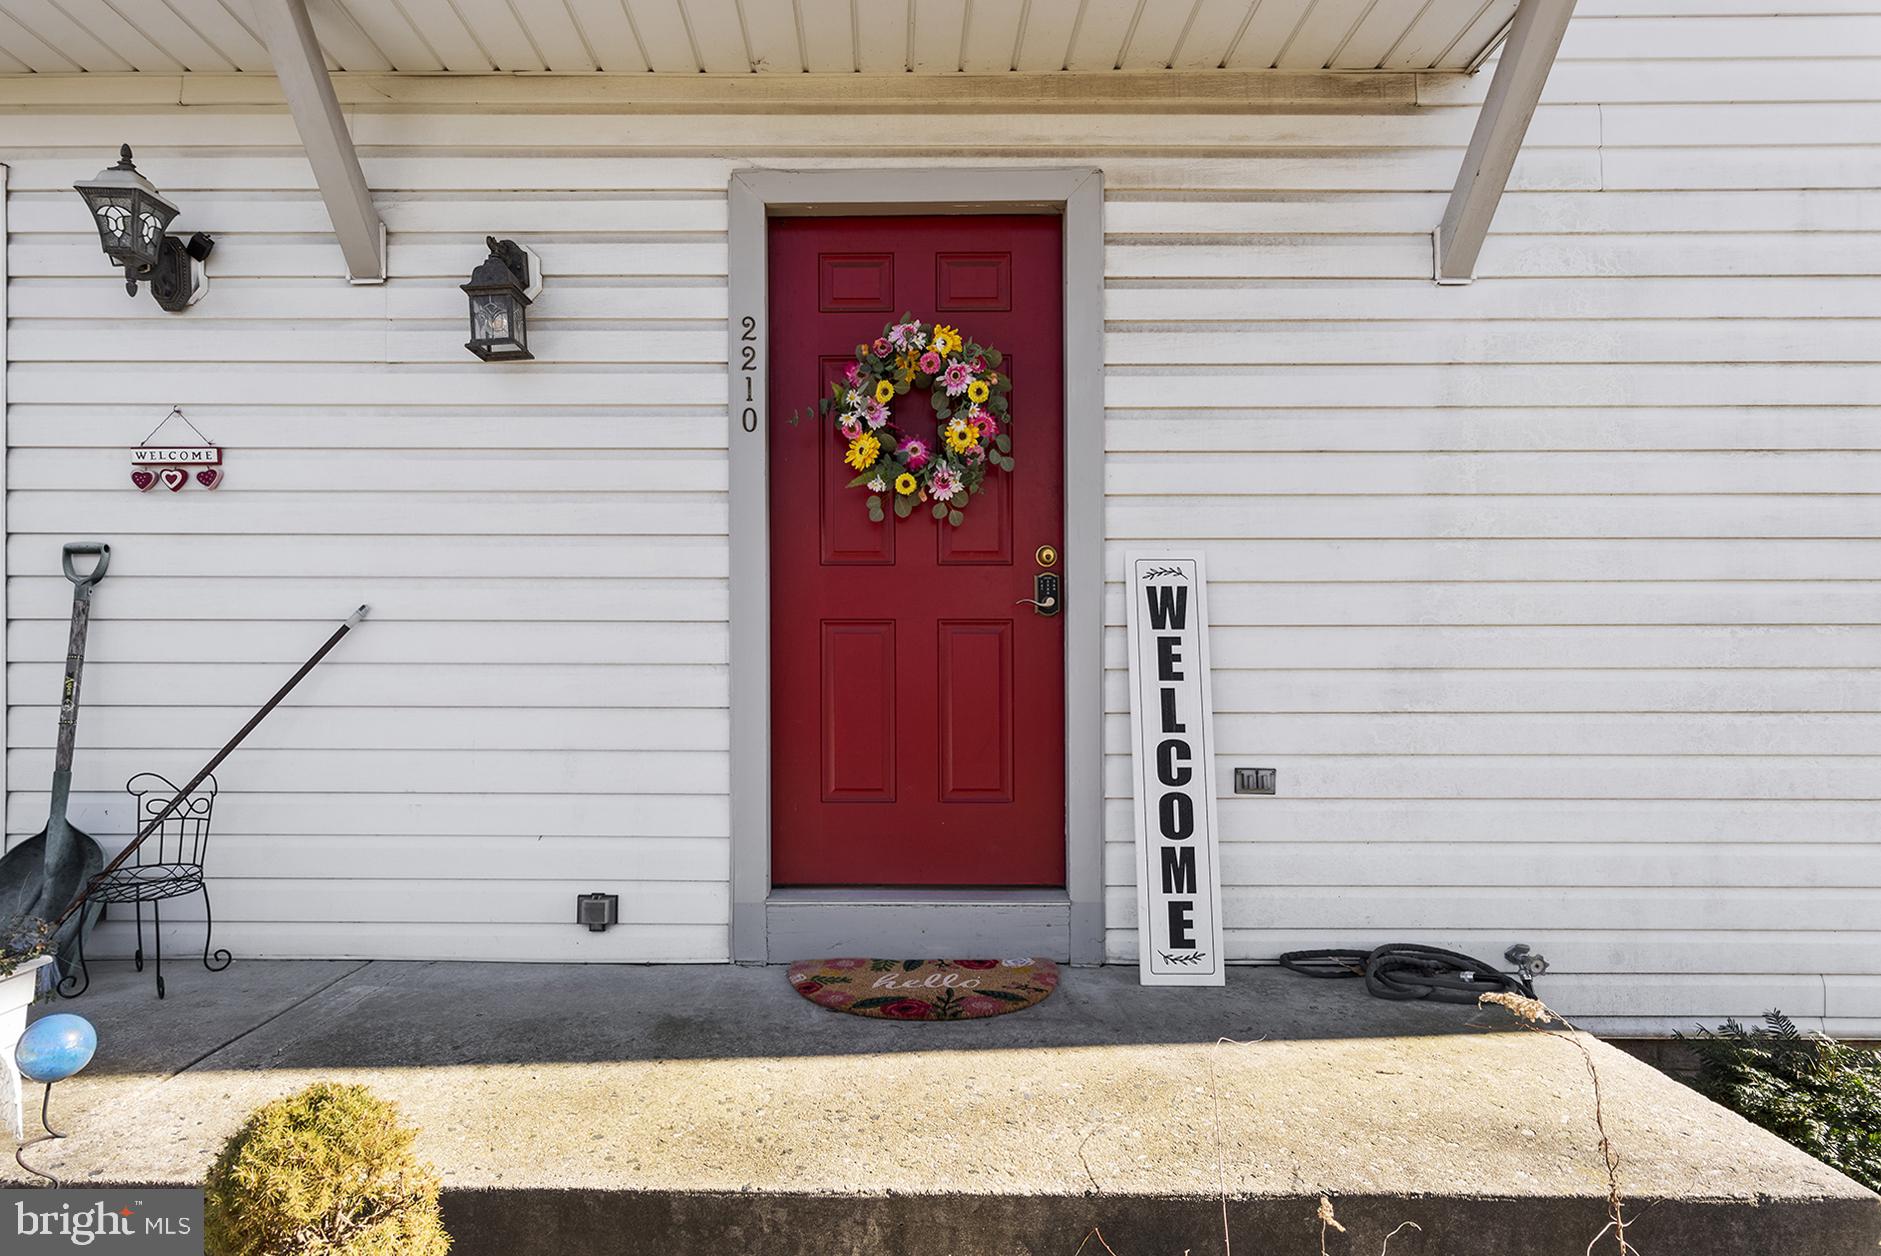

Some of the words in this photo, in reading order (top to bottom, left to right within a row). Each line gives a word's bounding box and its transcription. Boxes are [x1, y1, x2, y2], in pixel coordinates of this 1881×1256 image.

[741, 316, 757, 432] 2210
[135, 450, 213, 461] WELCOME
[1146, 586, 1197, 949] WELCOME
[872, 973, 981, 989] hello
